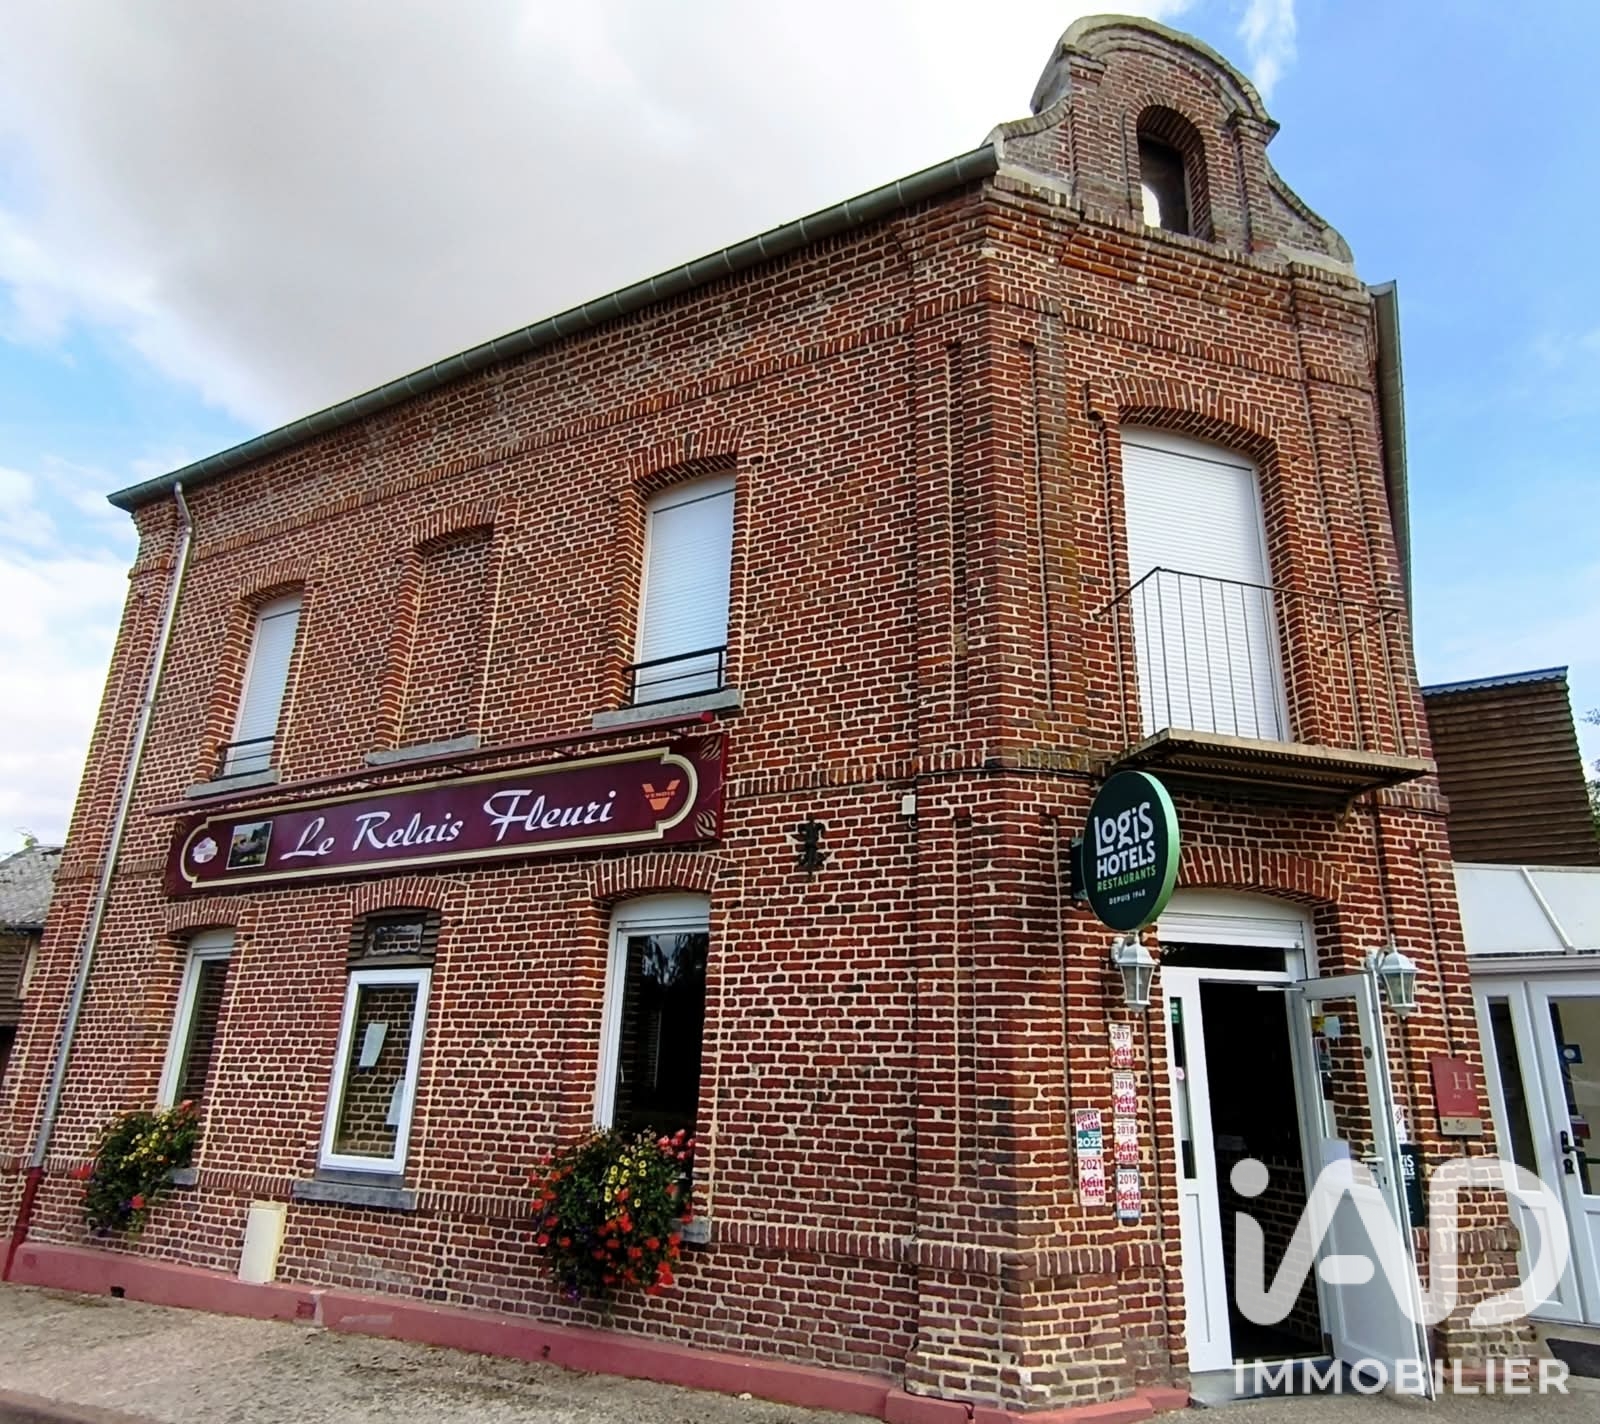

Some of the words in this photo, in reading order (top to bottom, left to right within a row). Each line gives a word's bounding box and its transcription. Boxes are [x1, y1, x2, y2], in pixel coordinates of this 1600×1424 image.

[280, 816, 335, 860] Le
[352, 811, 464, 852] Relais
[483, 789, 617, 842] Fleuri
[1096, 840, 1156, 879] HOTELS
[1097, 865, 1157, 892] RESTAURANTS
[1108, 893, 1131, 905] DEPUIS
[1112, 1031, 1130, 1040] 2017
[1115, 1081, 1133, 1090] 2016
[1452, 1071, 1473, 1091] H
[1117, 1126, 1134, 1134] 2018
[1078, 1137, 1102, 1148] 2022
[1080, 1159, 1102, 1170] 2021
[1080, 1177, 1103, 1190] petit
[1119, 1174, 1137, 1185] 2019
